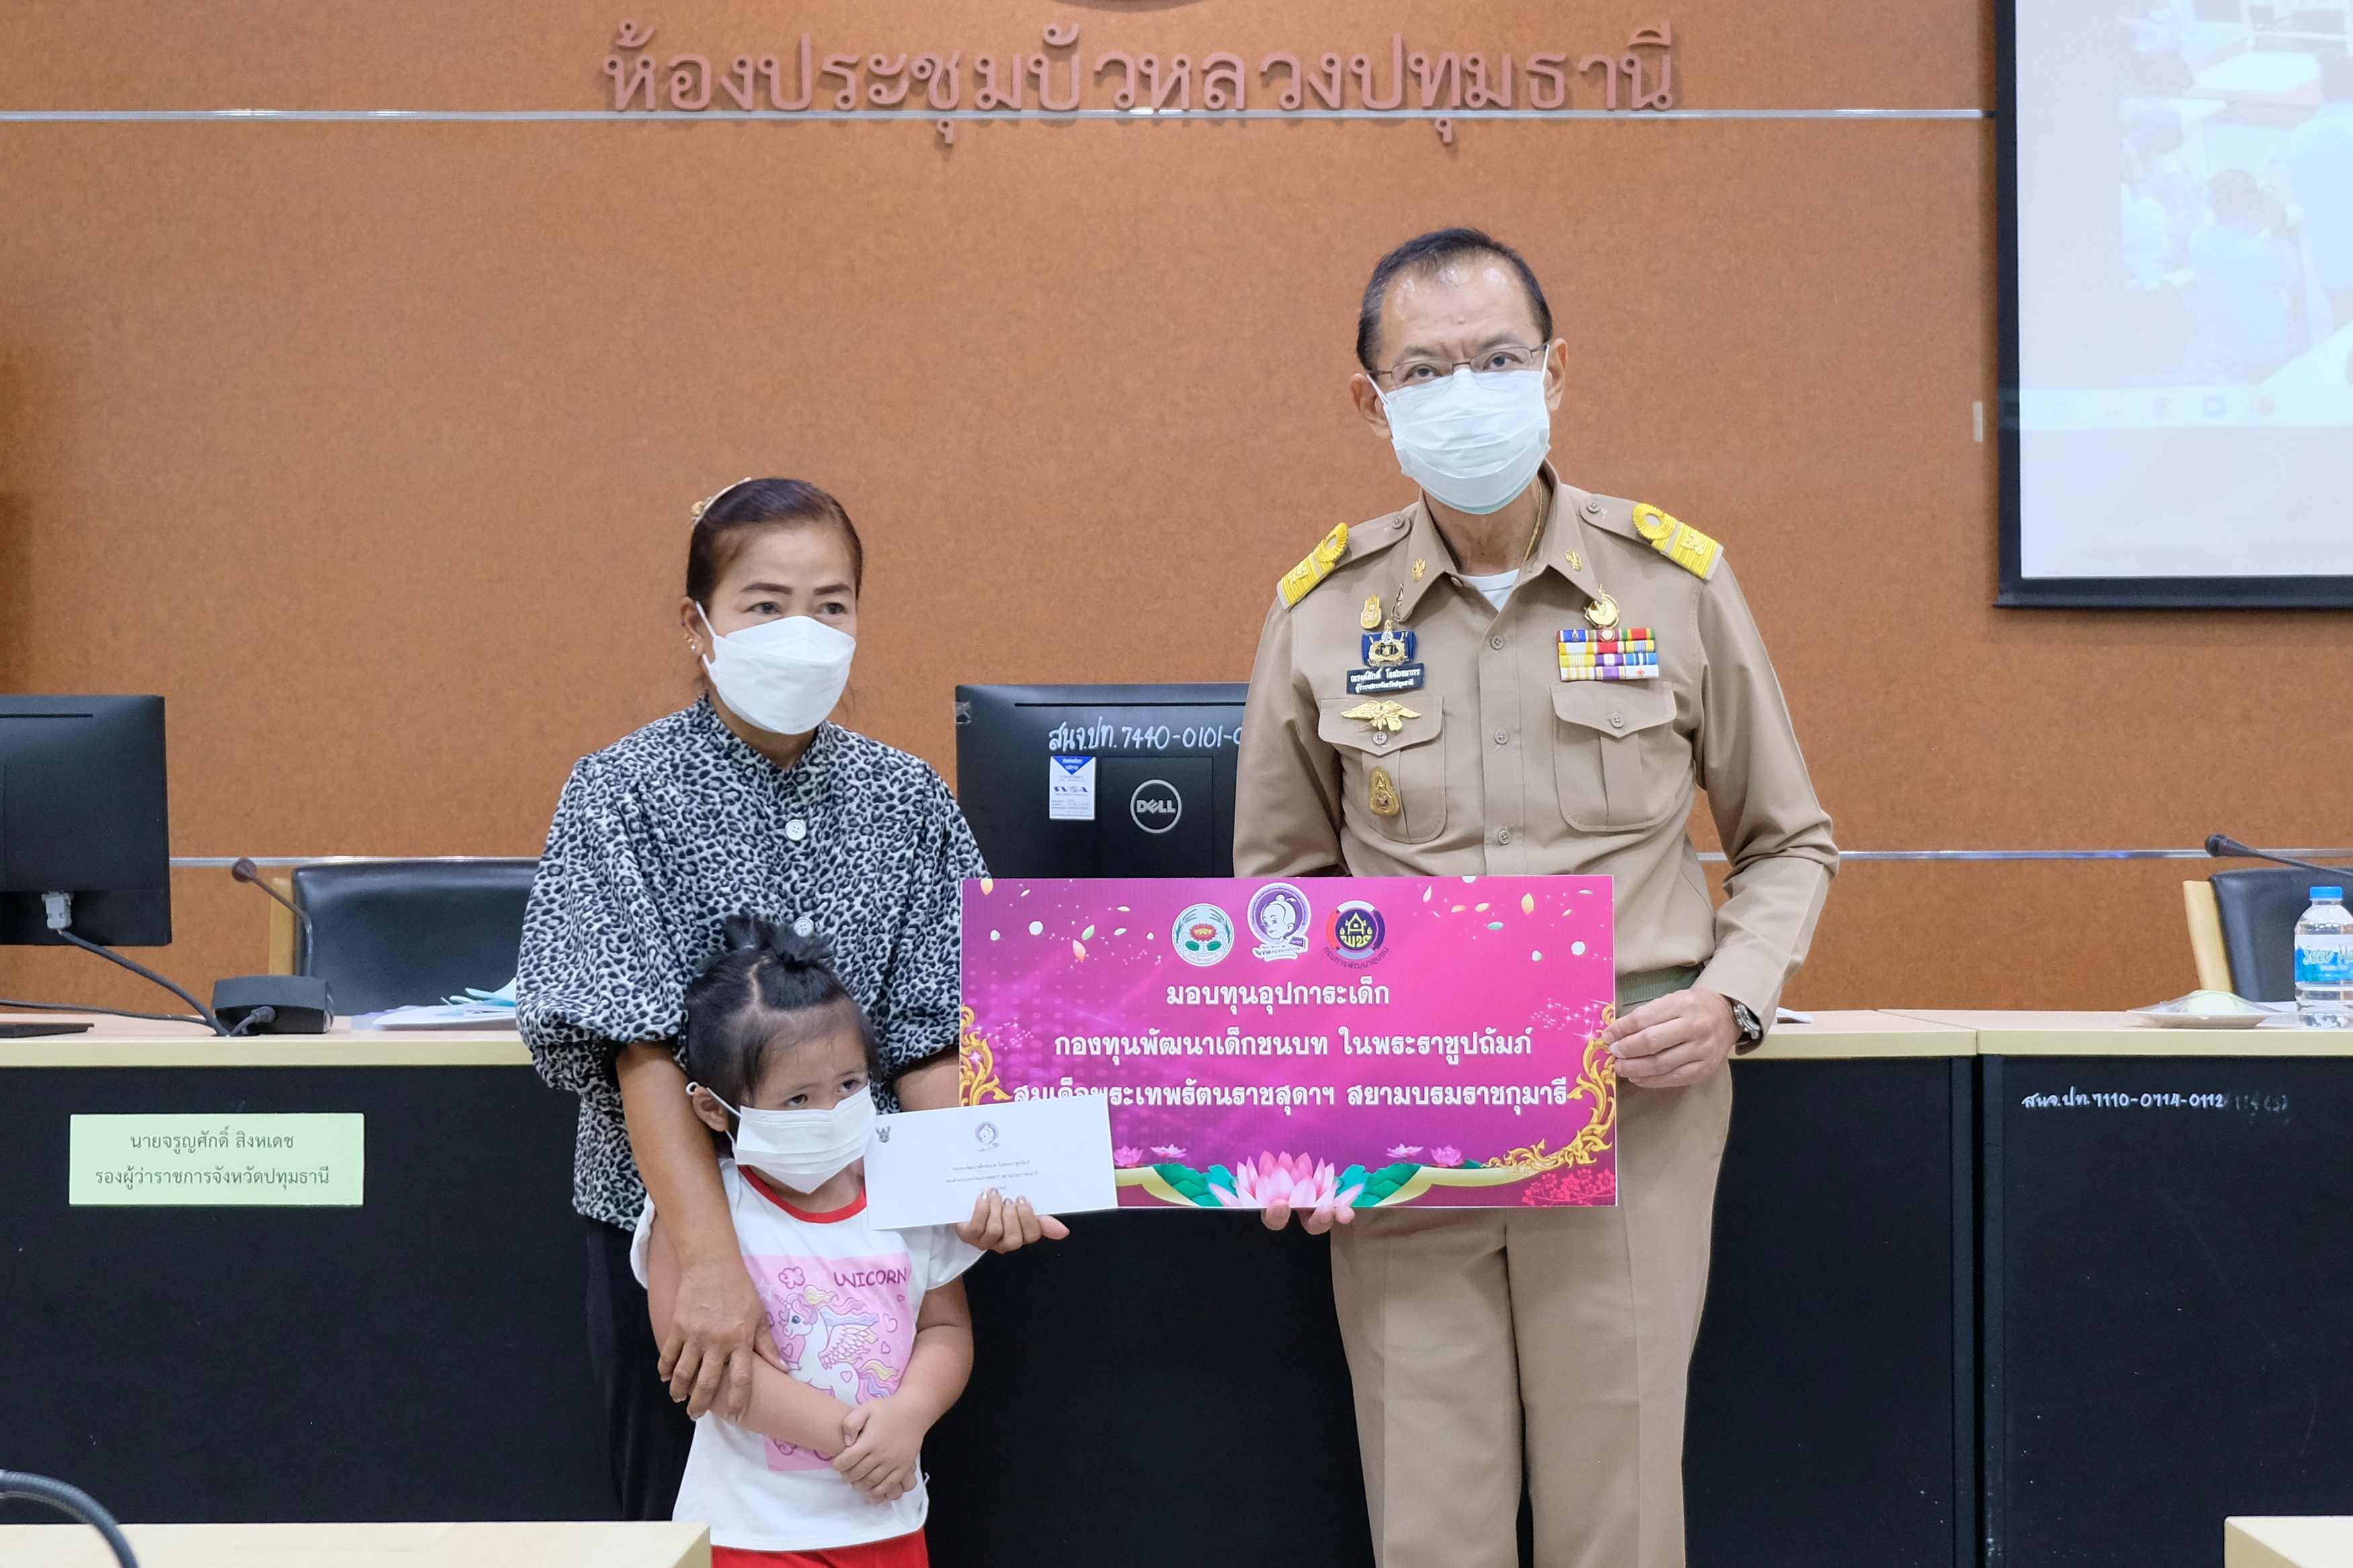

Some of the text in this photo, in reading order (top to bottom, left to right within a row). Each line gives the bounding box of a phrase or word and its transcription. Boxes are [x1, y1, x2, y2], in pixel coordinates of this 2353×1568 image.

[603, 19, 1673, 143] ห้องประชุมบัวหลวงปทุมธานี
[1136, 799, 1176, 814] DELL
[1166, 975, 1390, 1015] มอบทุนอุปการะเด็ก
[1054, 1026, 1533, 1066] กองทุนพัฒนาเด็กชนบท ในพระราชูปถัมภ์
[1347, 1077, 1568, 1116] สยามบรมราชกุมารี
[130, 1125, 294, 1155] นายจรูญศักดิ์ สิงหเดช
[95, 1165, 330, 1190] รองผู้ว่าราชการจังหวัดปทุมธานี
[834, 1268, 906, 1288] UNICORN
